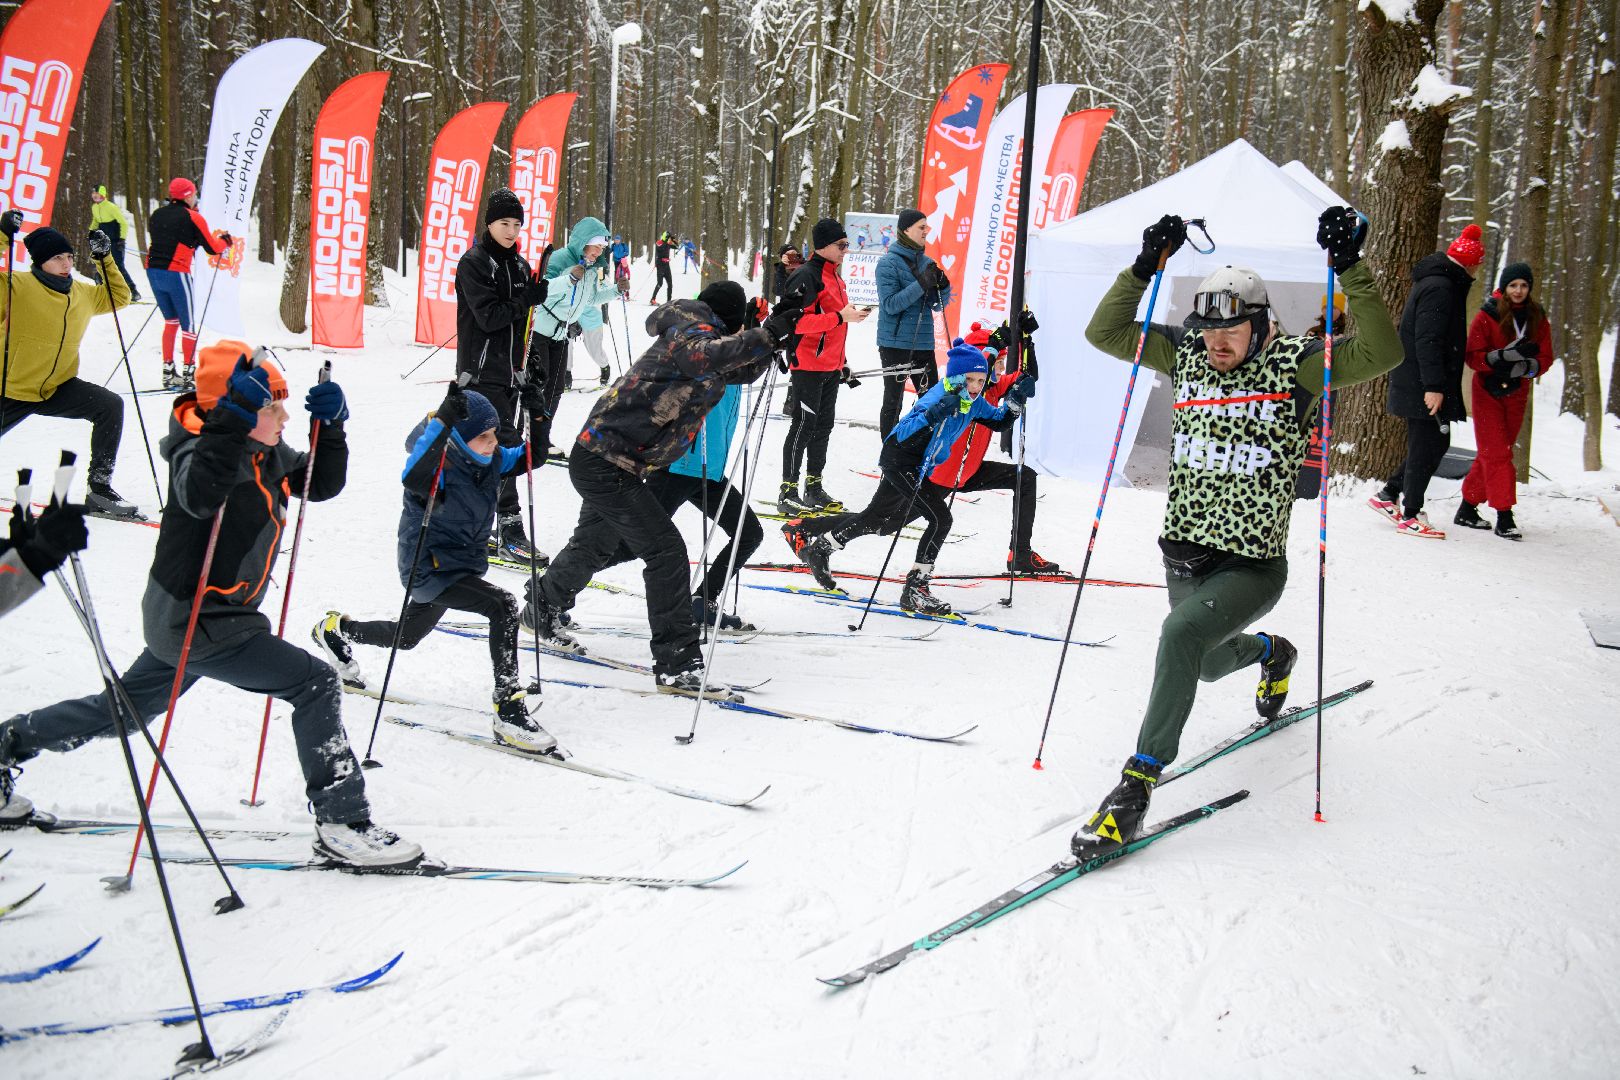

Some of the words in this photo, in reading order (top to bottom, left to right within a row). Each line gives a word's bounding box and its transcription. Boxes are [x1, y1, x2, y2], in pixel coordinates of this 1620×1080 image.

[993, 133, 1016, 200] КАЧЕСТВА
[314, 137, 346, 296] МОСОБЛ
[339, 173, 368, 298] СПОРТ
[423, 157, 457, 300] МОСОБЛ
[529, 177, 554, 271] ПОРТ
[983, 203, 1001, 273] ЛЫЖНОГО
[850, 264, 866, 278] 21
[976, 275, 991, 310] ЗНАК
